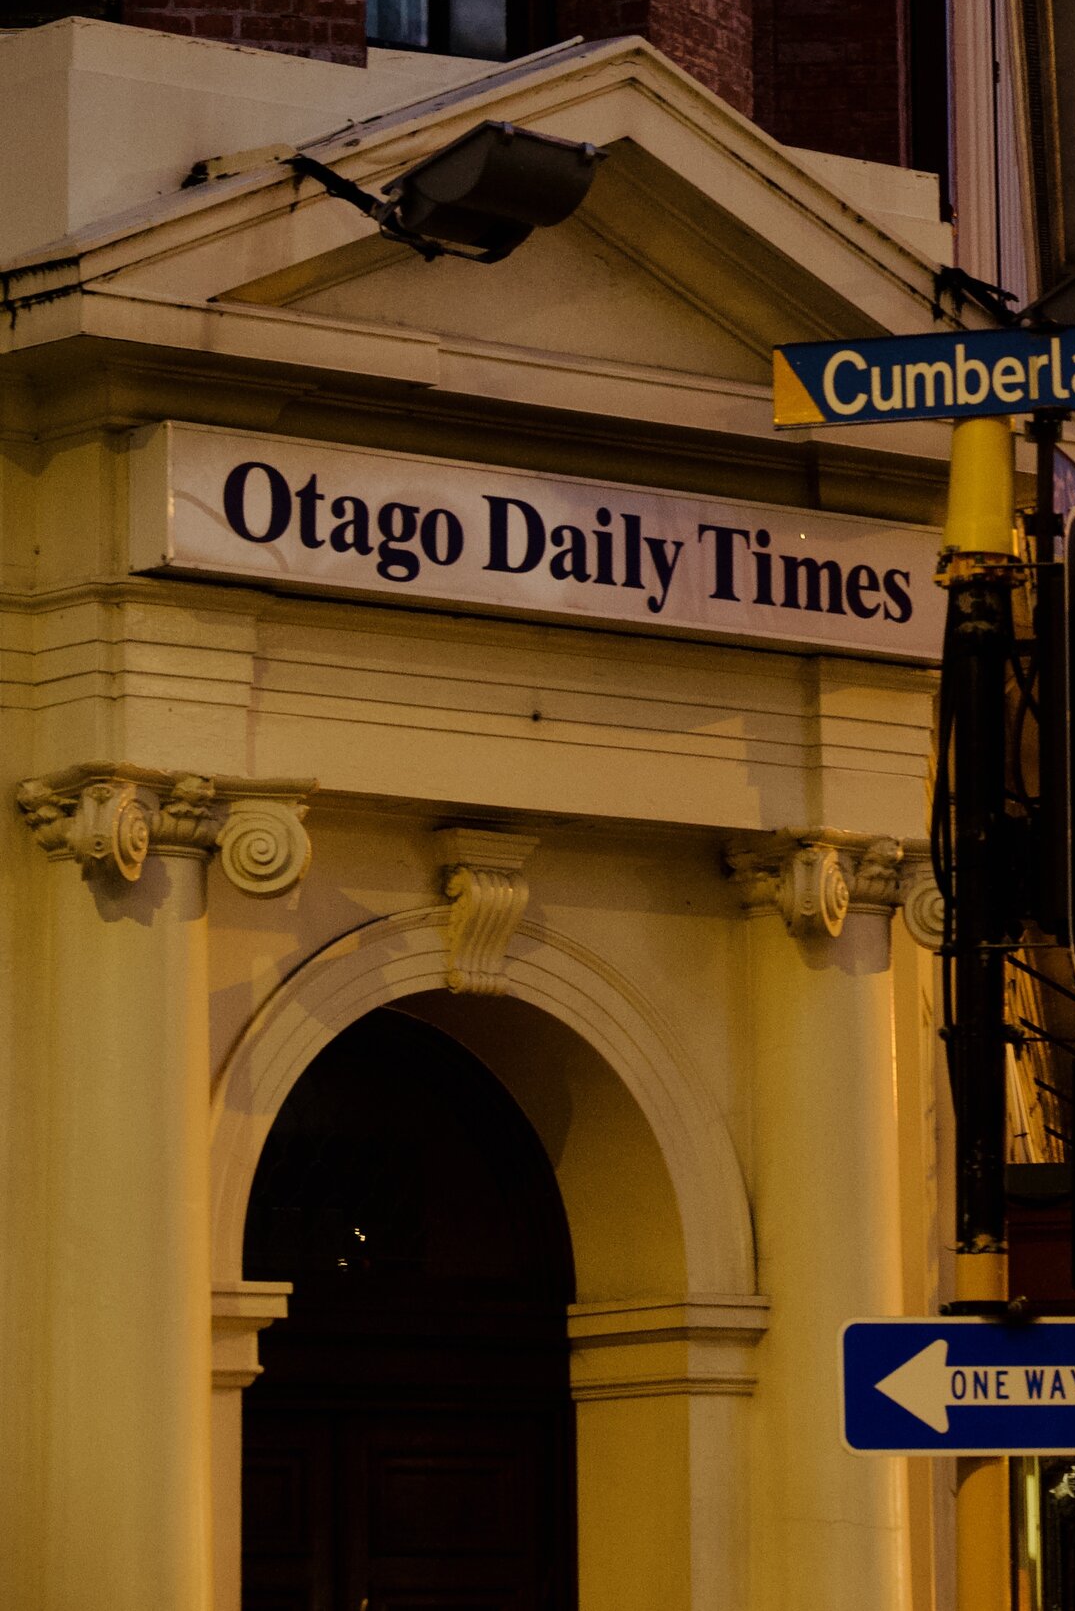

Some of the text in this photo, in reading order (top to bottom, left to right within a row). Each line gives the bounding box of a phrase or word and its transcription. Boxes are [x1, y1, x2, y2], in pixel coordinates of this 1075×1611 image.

[222, 461, 914, 624] Otago Daily Times
[951, 1369, 1010, 1400] ONE
